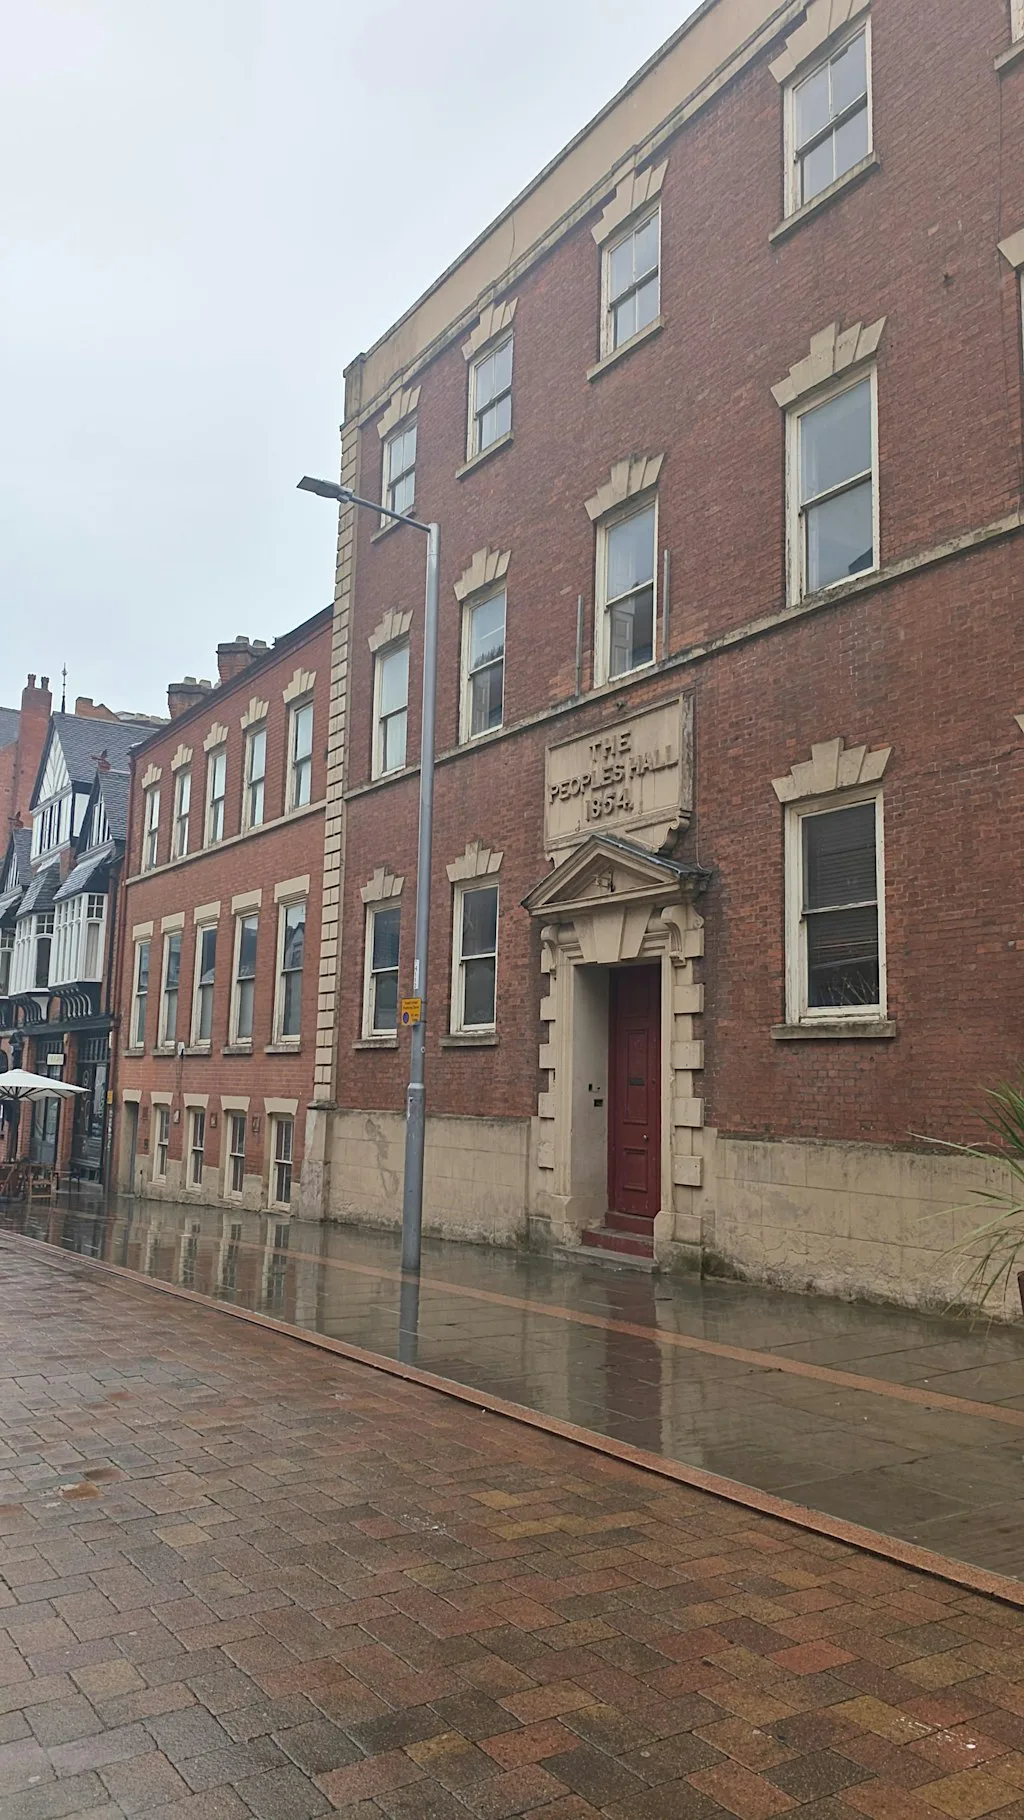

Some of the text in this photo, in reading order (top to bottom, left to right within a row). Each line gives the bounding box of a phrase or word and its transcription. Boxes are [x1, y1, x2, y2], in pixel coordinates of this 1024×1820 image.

[589, 731, 632, 763] THE
[549, 744, 679, 805] PEOPLES HALL
